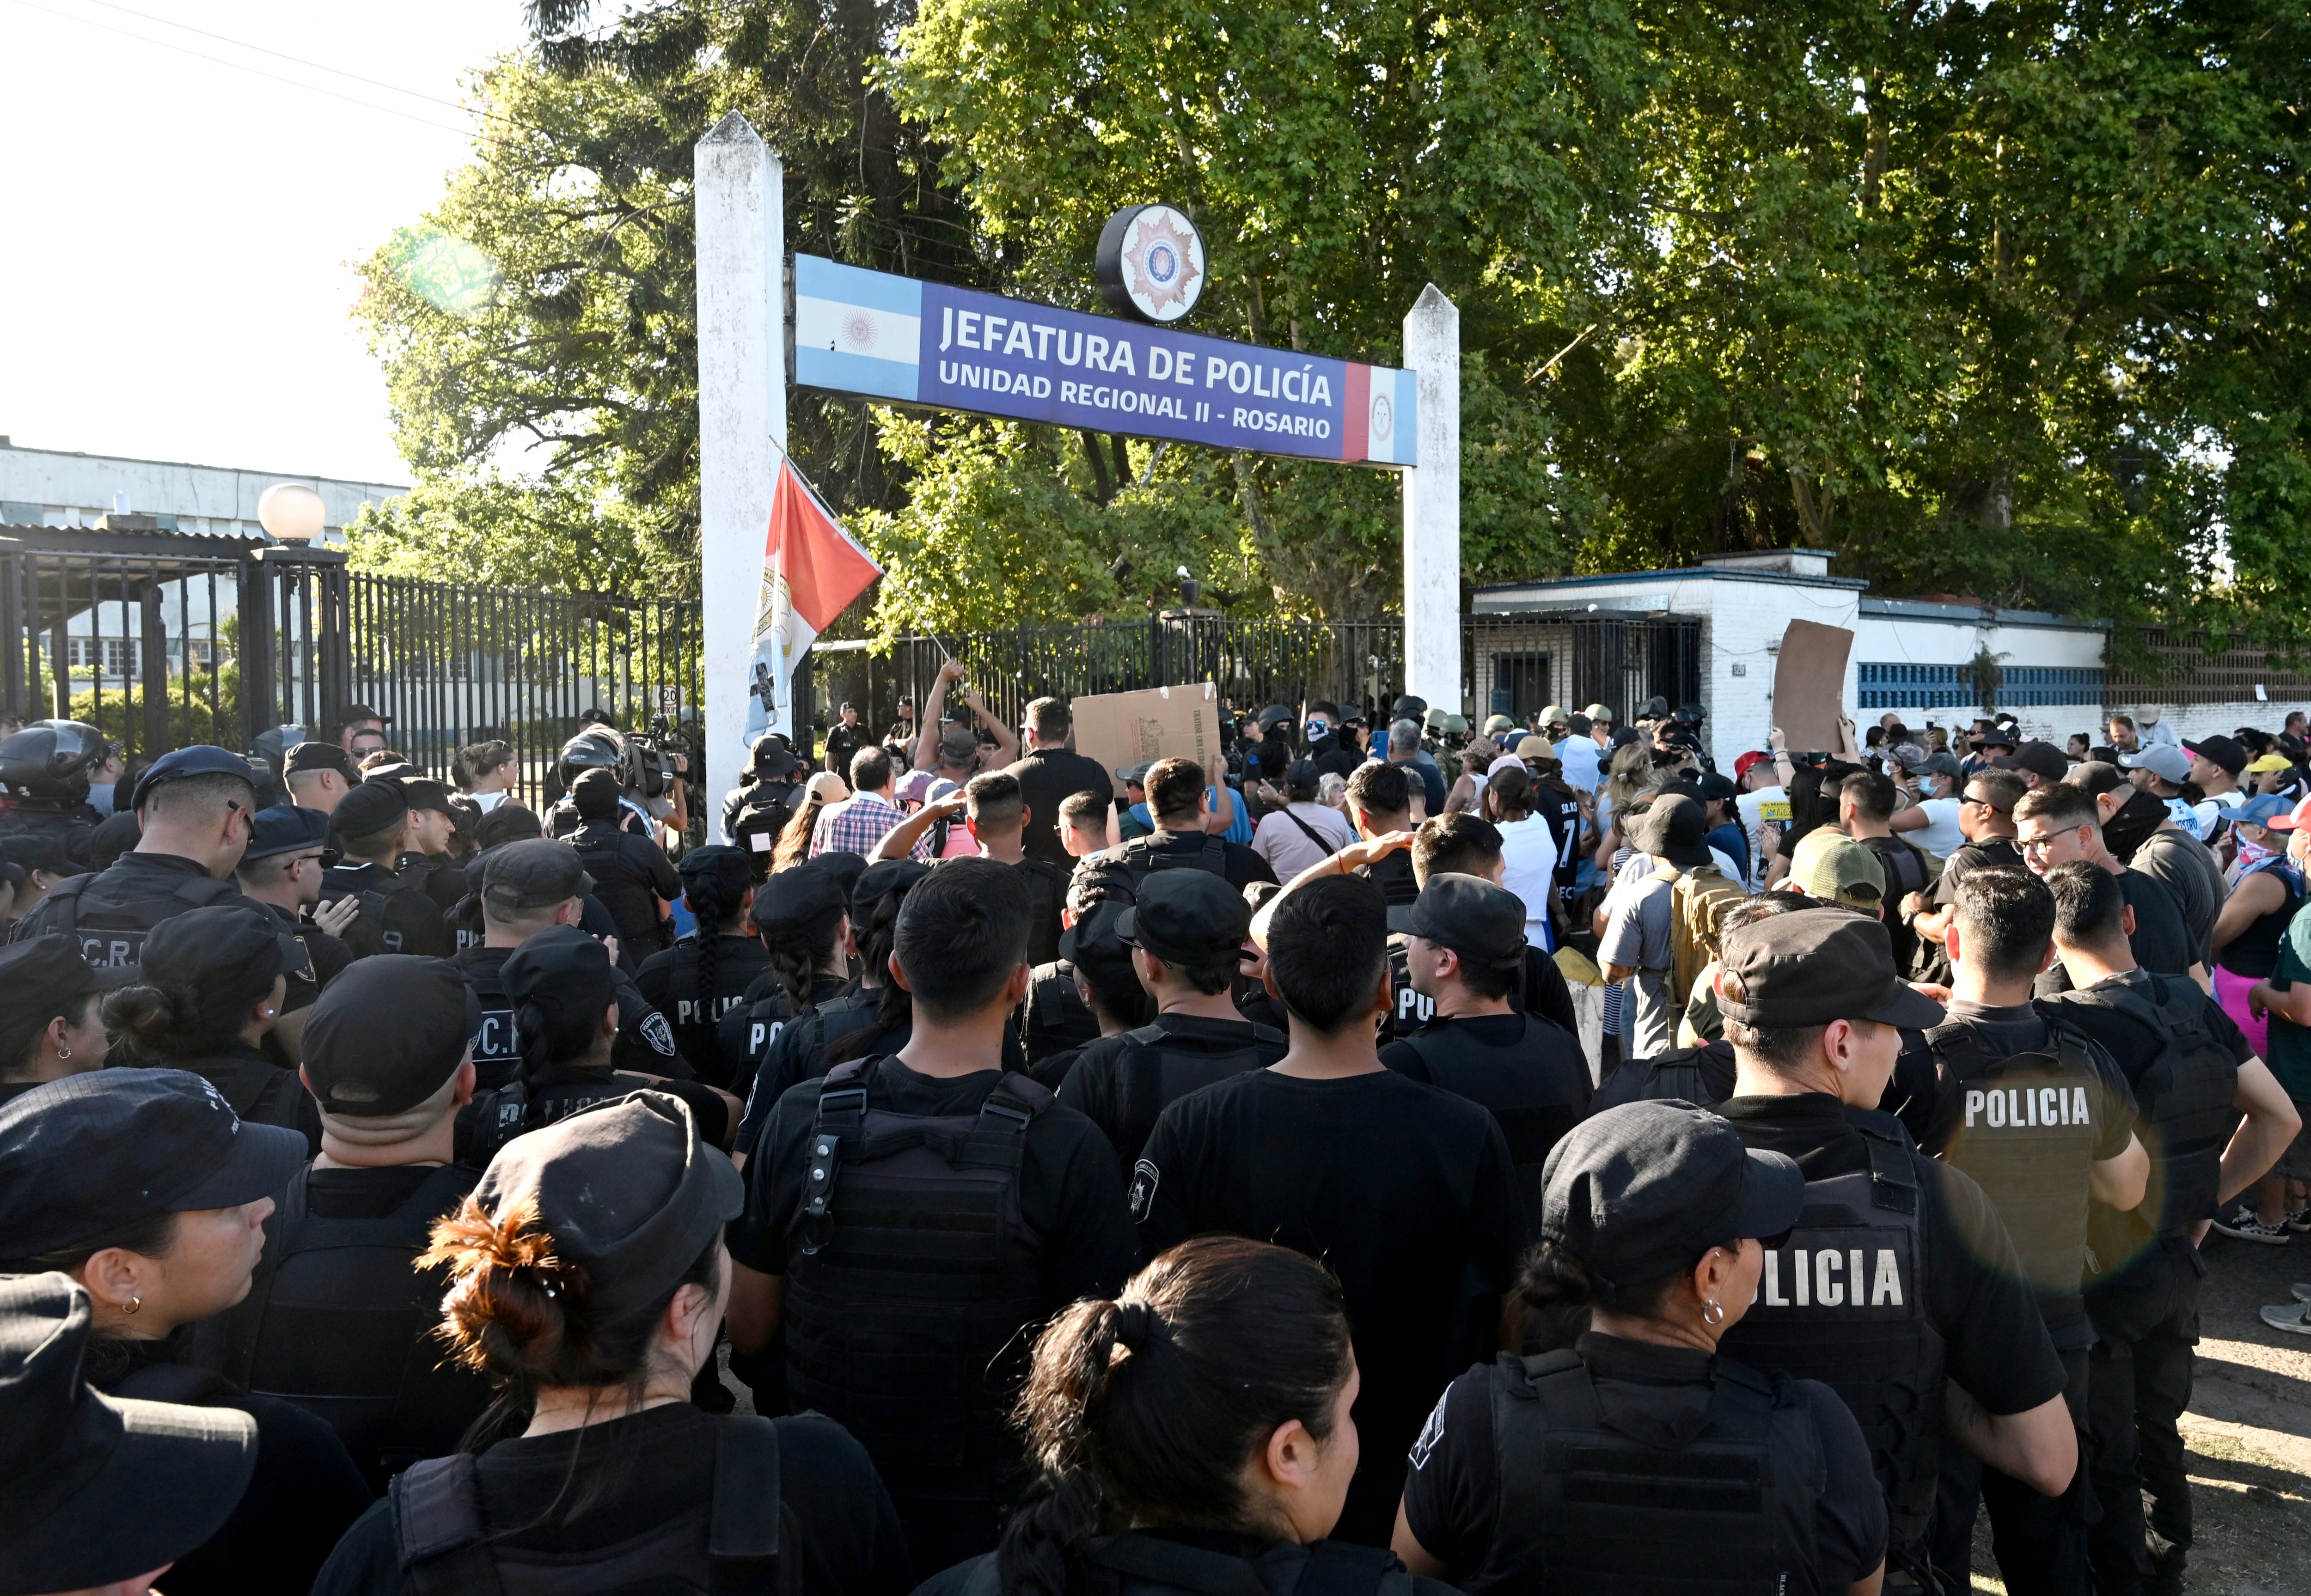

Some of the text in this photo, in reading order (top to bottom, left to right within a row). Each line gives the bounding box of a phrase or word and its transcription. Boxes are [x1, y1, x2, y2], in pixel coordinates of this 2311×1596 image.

[939, 307, 1332, 407] JEFATURA DE POLICÍA
[940, 360, 1051, 398] UNIDAD
[1060, 381, 1187, 420] REGIONAL
[1195, 402, 1209, 422] II
[1233, 407, 1330, 439] ROSARIO
[664, 689, 676, 701] 20
[1559, 820, 1575, 868] 7
[2175, 817, 2197, 831] OSTRO
[83, 939, 144, 967] C.R.
[1966, 1087, 2090, 1127] POLICIA
[1750, 1249, 1903, 1307] LICIA
